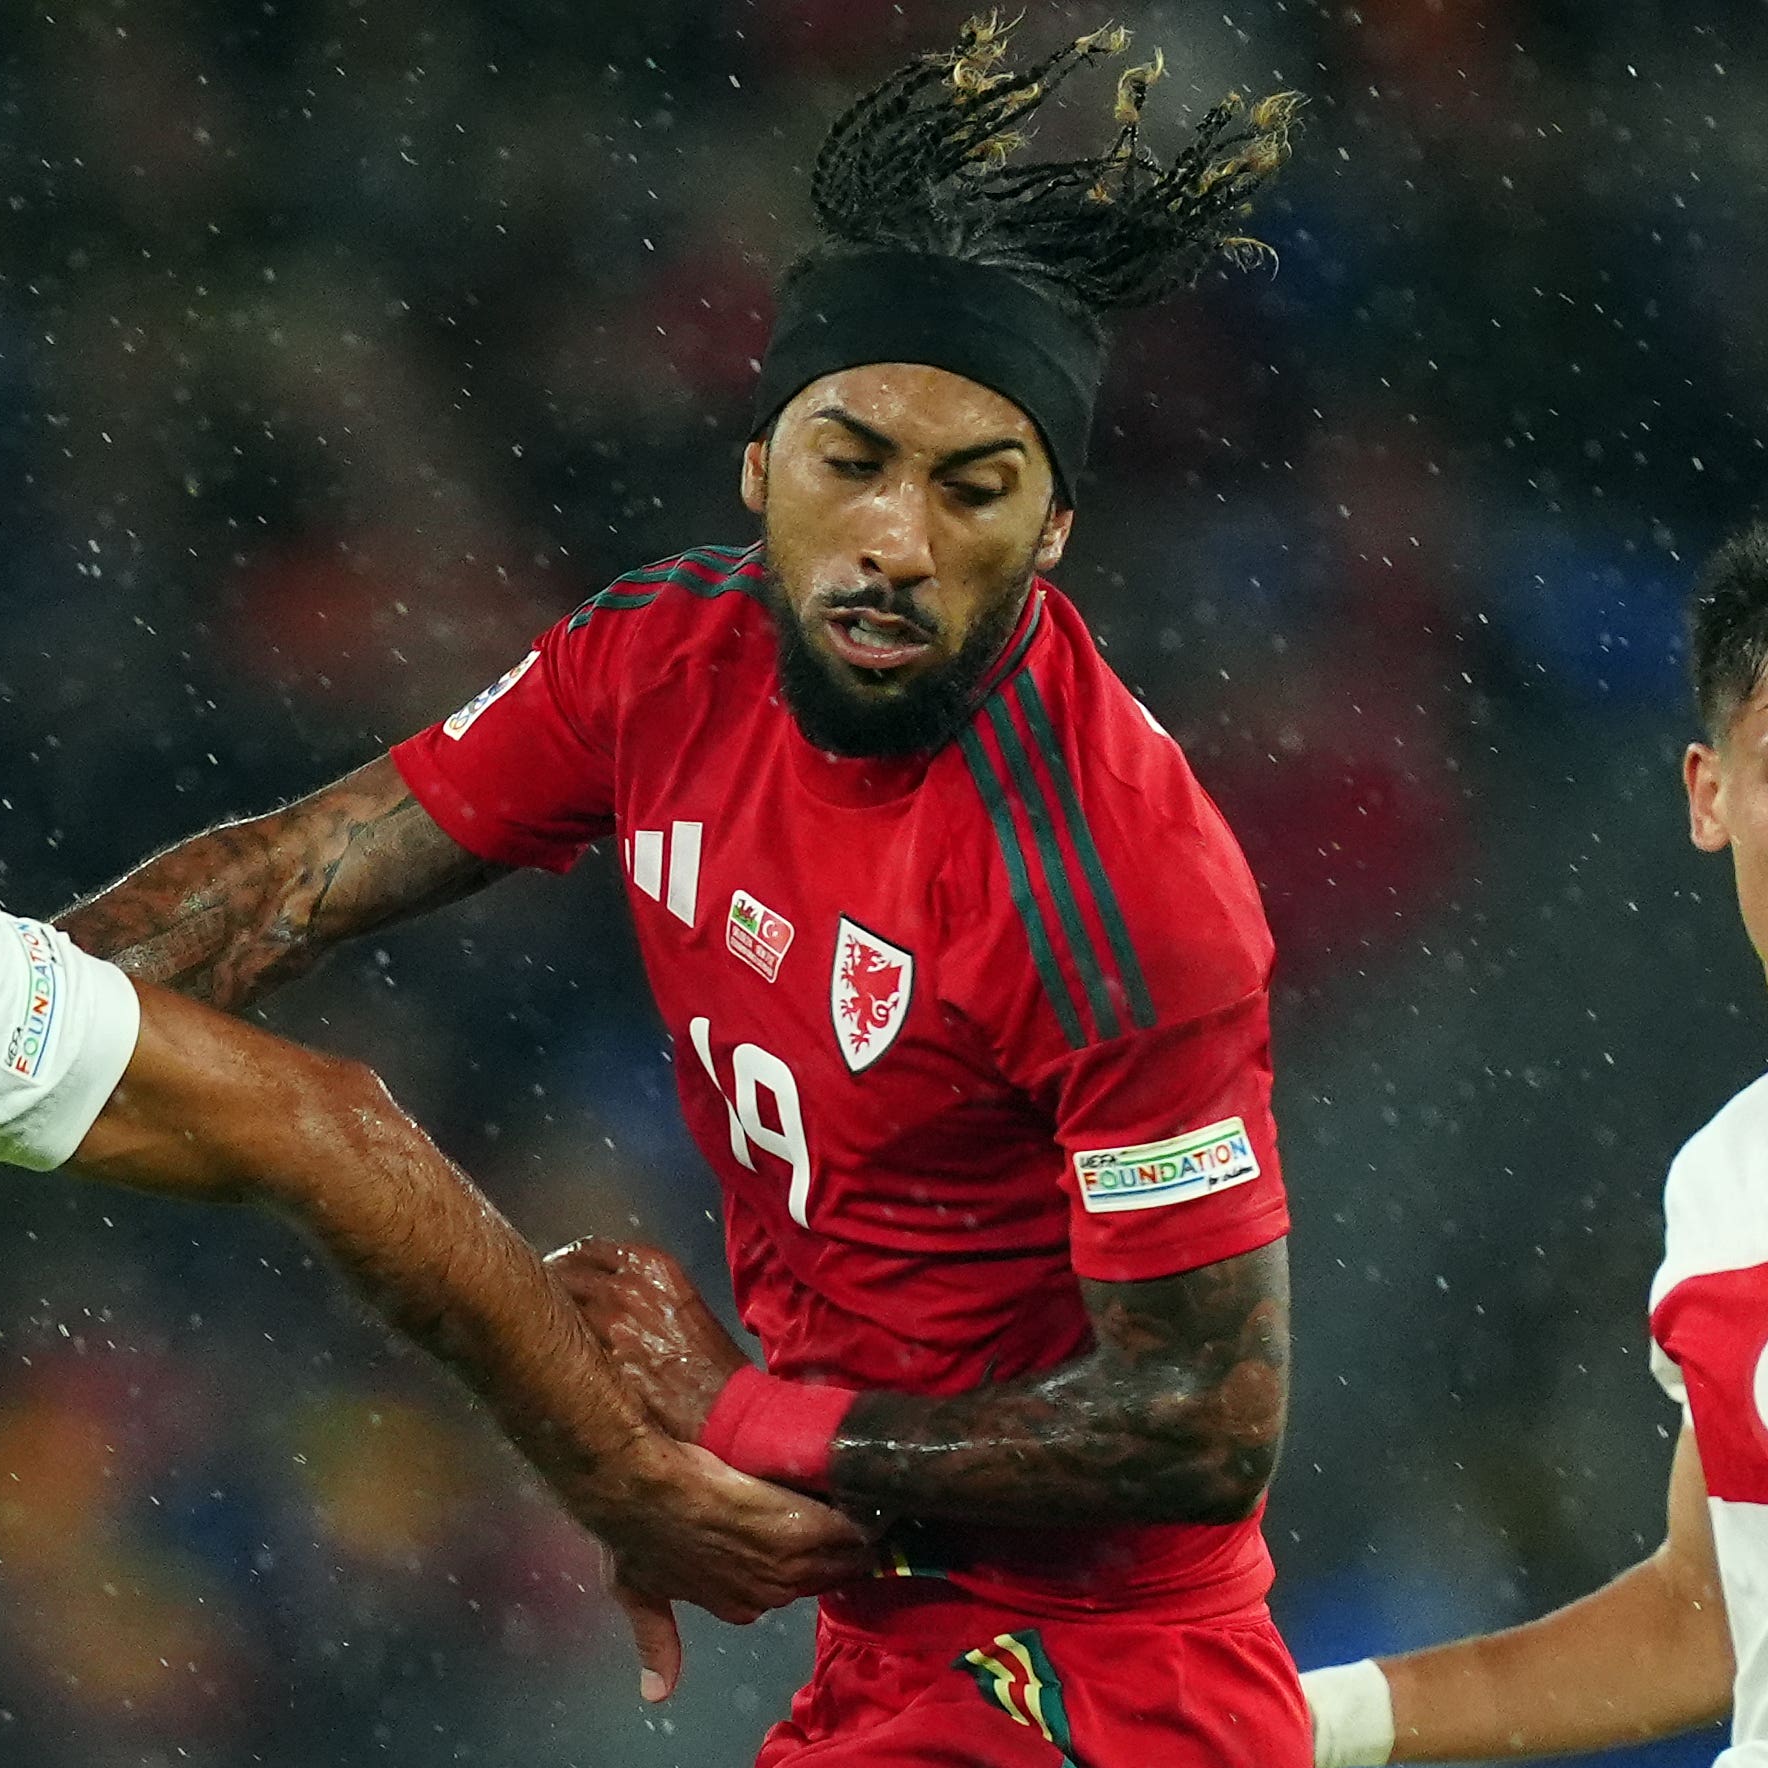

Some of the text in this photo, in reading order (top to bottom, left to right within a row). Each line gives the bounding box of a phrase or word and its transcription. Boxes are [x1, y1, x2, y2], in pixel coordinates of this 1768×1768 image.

[15, 923, 51, 1076] FOUNDATION
[689, 1016, 811, 1230] 19
[1080, 1153, 1116, 1168] UEFA
[1083, 1136, 1248, 1191] FOUNDATION
